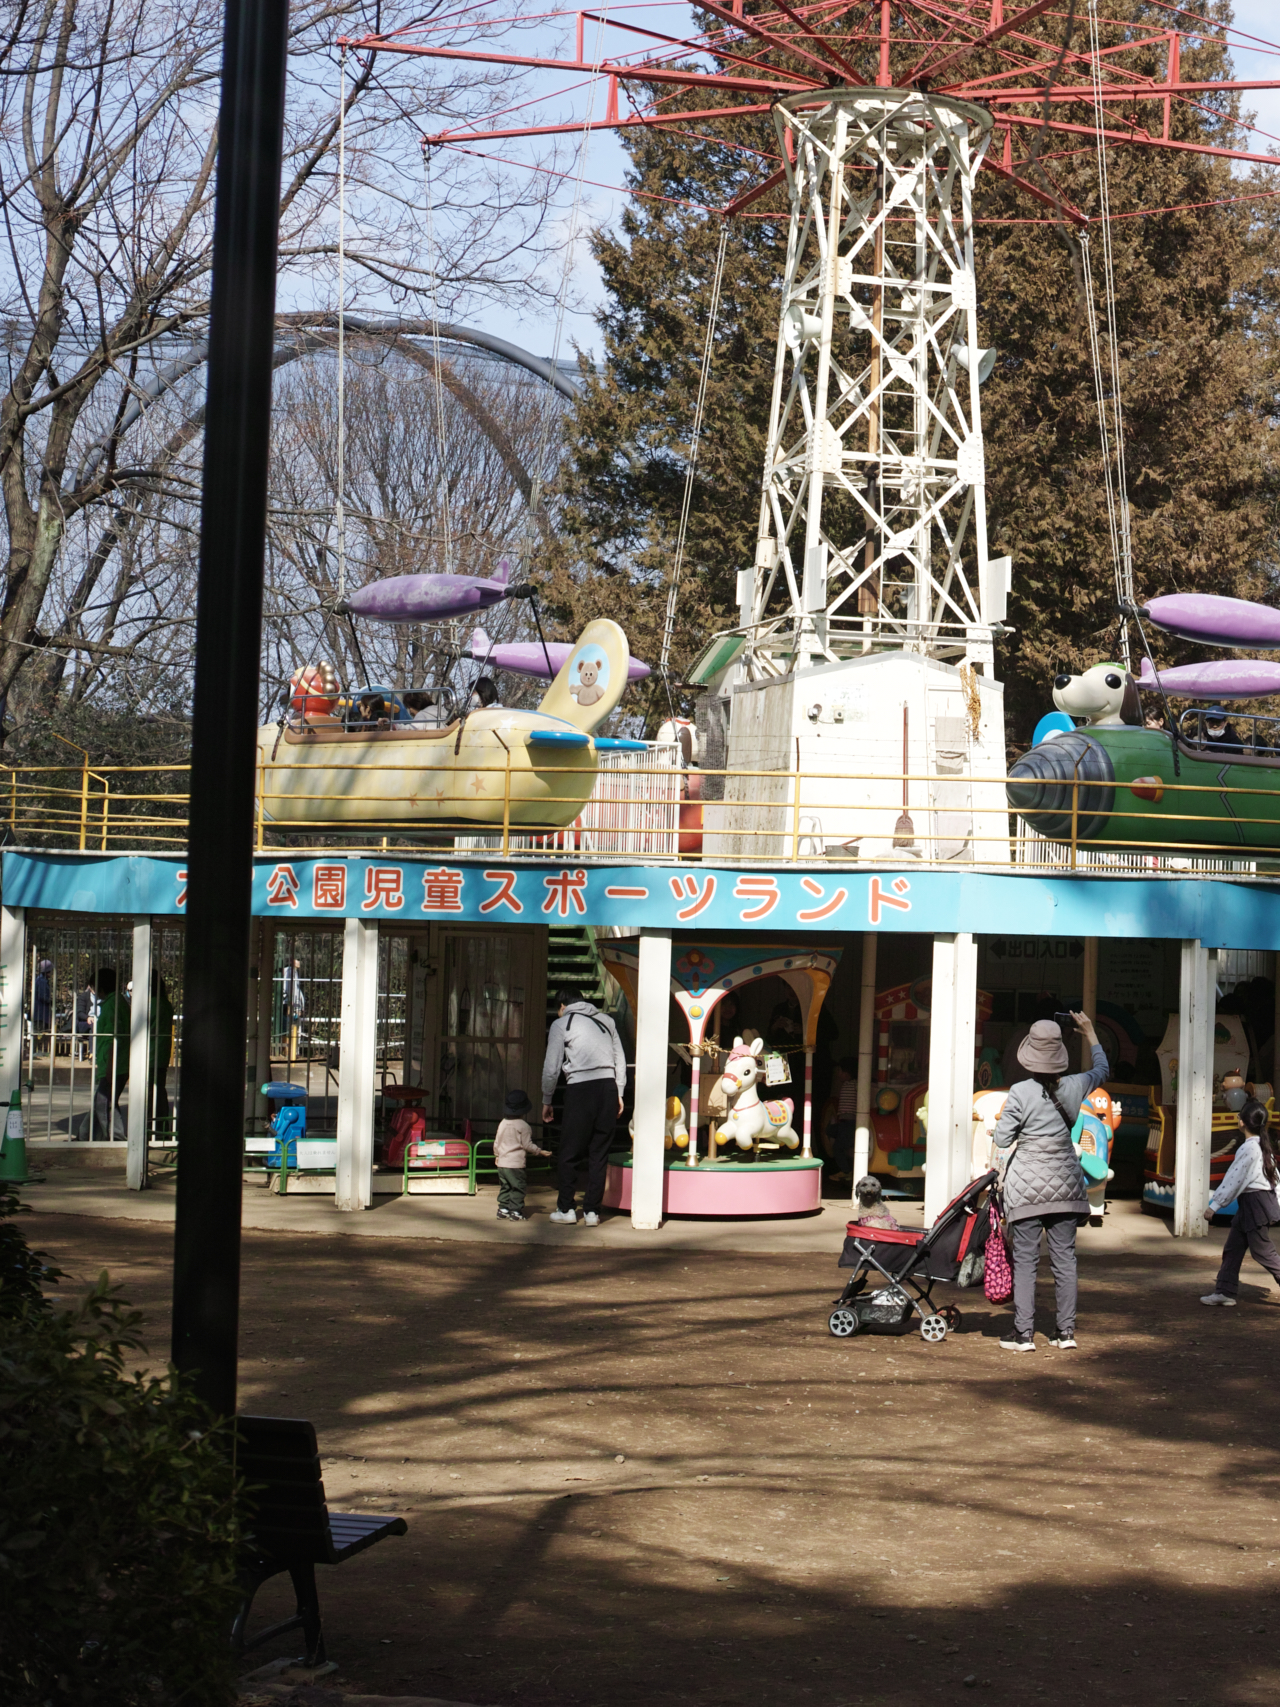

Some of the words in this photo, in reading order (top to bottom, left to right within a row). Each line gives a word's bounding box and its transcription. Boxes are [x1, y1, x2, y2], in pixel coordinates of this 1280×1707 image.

[176, 863, 913, 926] 公園児童スポーツランド
[1008, 940, 1036, 958] 出口
[1040, 940, 1067, 958] 入口
